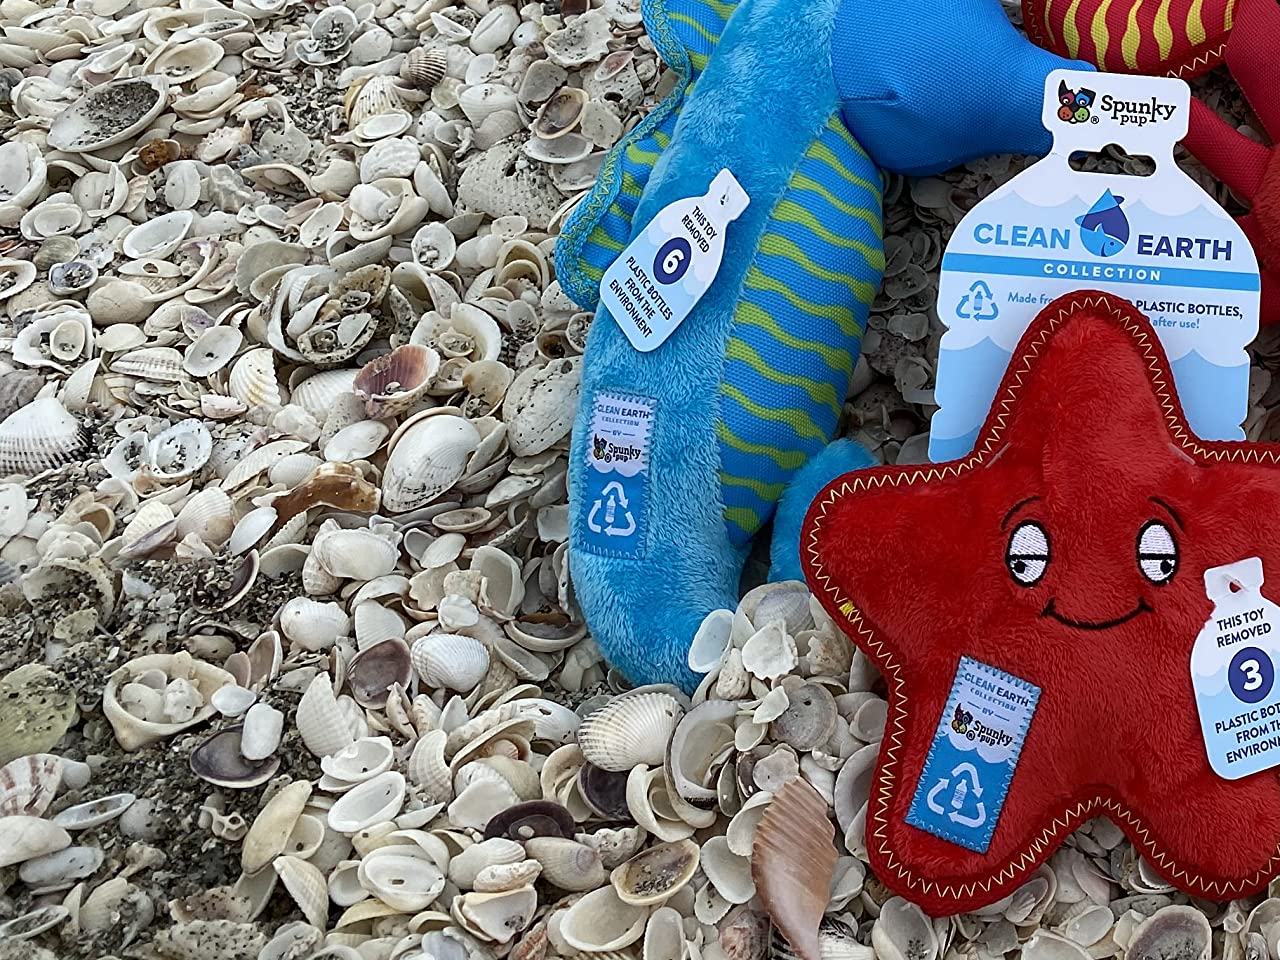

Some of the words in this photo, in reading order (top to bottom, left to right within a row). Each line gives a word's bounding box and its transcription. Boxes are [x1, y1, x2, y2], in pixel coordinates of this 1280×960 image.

[1100, 95, 1177, 123] Spunky
[1120, 115, 1148, 127] pup
[681, 214, 710, 253] REMOVED
[691, 206, 707, 227] THIS
[705, 224, 718, 240] TOY
[973, 223, 1070, 250] CLEAN
[1137, 234, 1233, 261] EARTH
[662, 248, 685, 275] 6
[1043, 263, 1161, 281] COLLECTION
[624, 278, 645, 305] FROM
[640, 301, 656, 320] THE
[626, 256, 653, 289] PLASTIC
[647, 285, 673, 321] BOTTLES
[609, 279, 653, 338] ENVIRONMENT
[1007, 292, 1037, 304] Made
[1136, 300, 1185, 314] PLASTIC
[1187, 302, 1243, 320] BOTTLES,
[1153, 315, 1177, 328] after
[1179, 318, 1200, 329] use!
[597, 404, 620, 416] CLEAN
[621, 407, 650, 419] EARTH
[608, 442, 641, 461] Spunky
[615, 453, 628, 462] pup
[1217, 616, 1243, 631] THIS
[1243, 608, 1265, 624] TOY
[1216, 622, 1271, 648] REMOVED
[1239, 659, 1263, 691] 3
[964, 673, 996, 693] CLEAN
[996, 687, 1029, 707] EARTH
[970, 687, 1016, 712] COLLECTION
[973, 720, 1013, 747] Spunky
[1215, 711, 1259, 734] PLASTIC
[1236, 723, 1270, 743] FROM
[980, 735, 996, 746] pup
